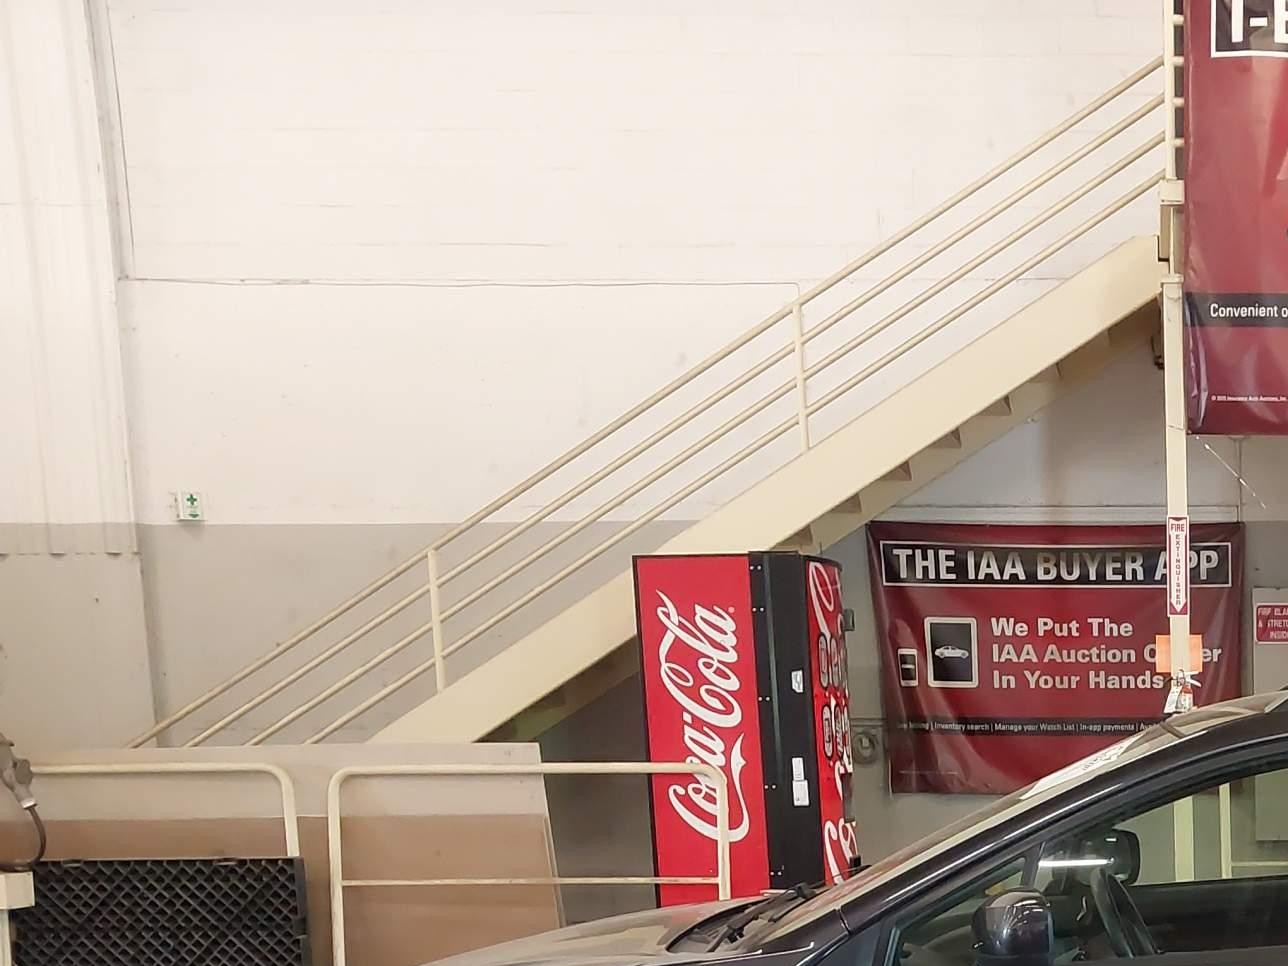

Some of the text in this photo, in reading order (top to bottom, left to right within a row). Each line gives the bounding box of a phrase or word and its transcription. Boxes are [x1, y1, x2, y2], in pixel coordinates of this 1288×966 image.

[1210, 303, 1279, 318] Convenient
[1170, 523, 1185, 532] FIRE
[892, 548, 957, 580] THE
[967, 550, 1026, 581] IAA
[1036, 551, 1145, 581] BUYER
[991, 617, 1133, 637] We Put The
[992, 644, 1038, 662] IAA
[1043, 644, 1136, 663] Auction
[993, 670, 1164, 689] In Your Hands
[934, 721, 966, 732] Inventory
[966, 722, 990, 731] search
[994, 722, 1022, 732] Manage
[1023, 724, 1038, 732] your
[1039, 722, 1061, 731] Watch
[1063, 722, 1076, 731] List
[1080, 722, 1101, 733] In-app
[1103, 723, 1135, 732] payments
